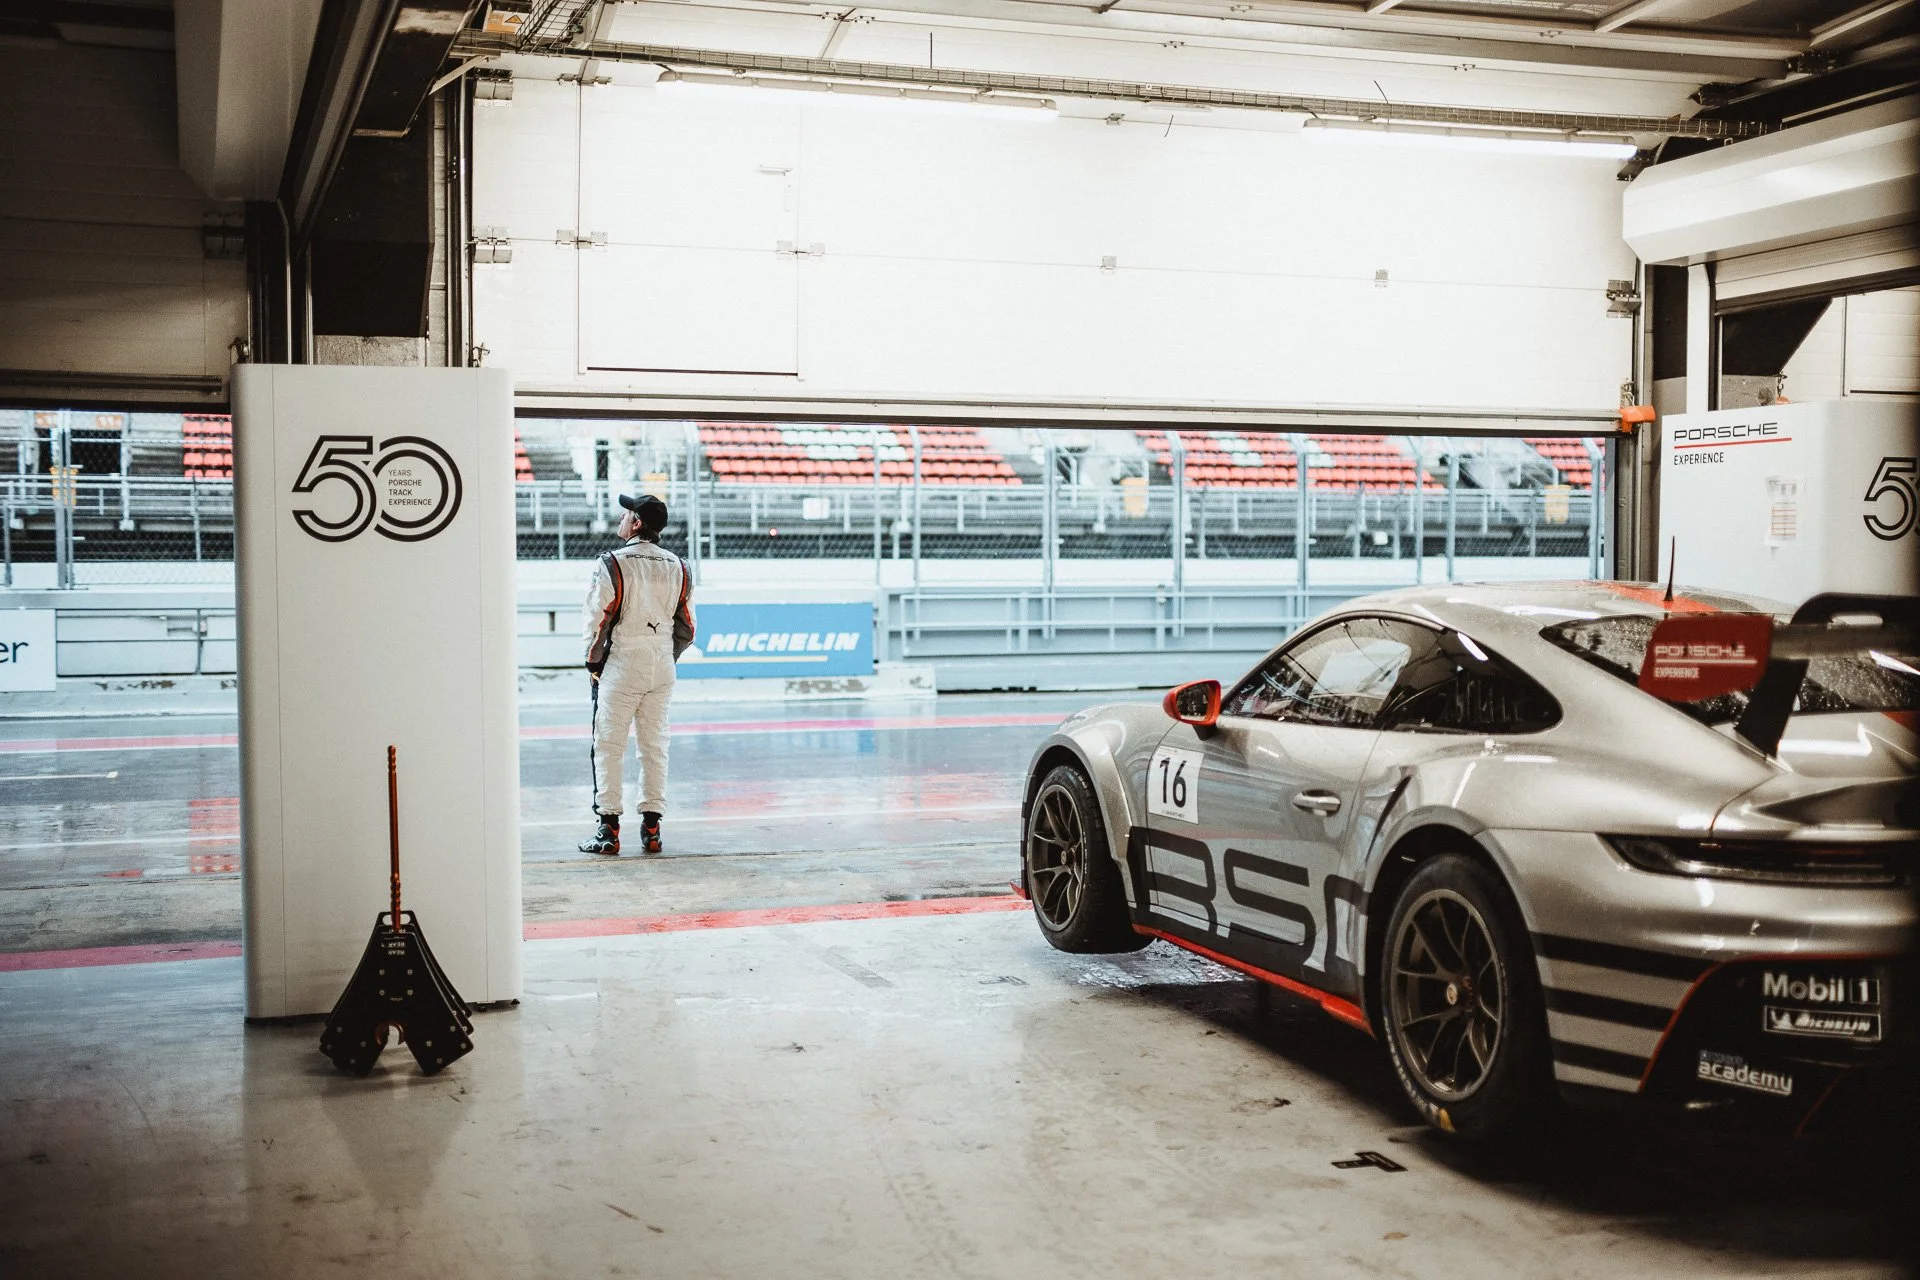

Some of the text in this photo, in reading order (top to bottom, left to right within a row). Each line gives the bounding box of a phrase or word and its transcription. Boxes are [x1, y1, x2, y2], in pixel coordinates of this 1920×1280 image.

[1674, 422, 1778, 441] PORSCHE
[1674, 452, 1725, 465] EXPERIENCE
[292, 435, 463, 542] 50
[1863, 457, 1920, 541] 5
[388, 498, 432, 506] EXPERIENCE
[707, 632, 860, 653] MICHELIN
[1655, 645, 1746, 657] PORSCHE
[1159, 757, 1187, 809] 16
[1763, 972, 1845, 1002] Mobil
[1698, 1061, 1793, 1093] academy
